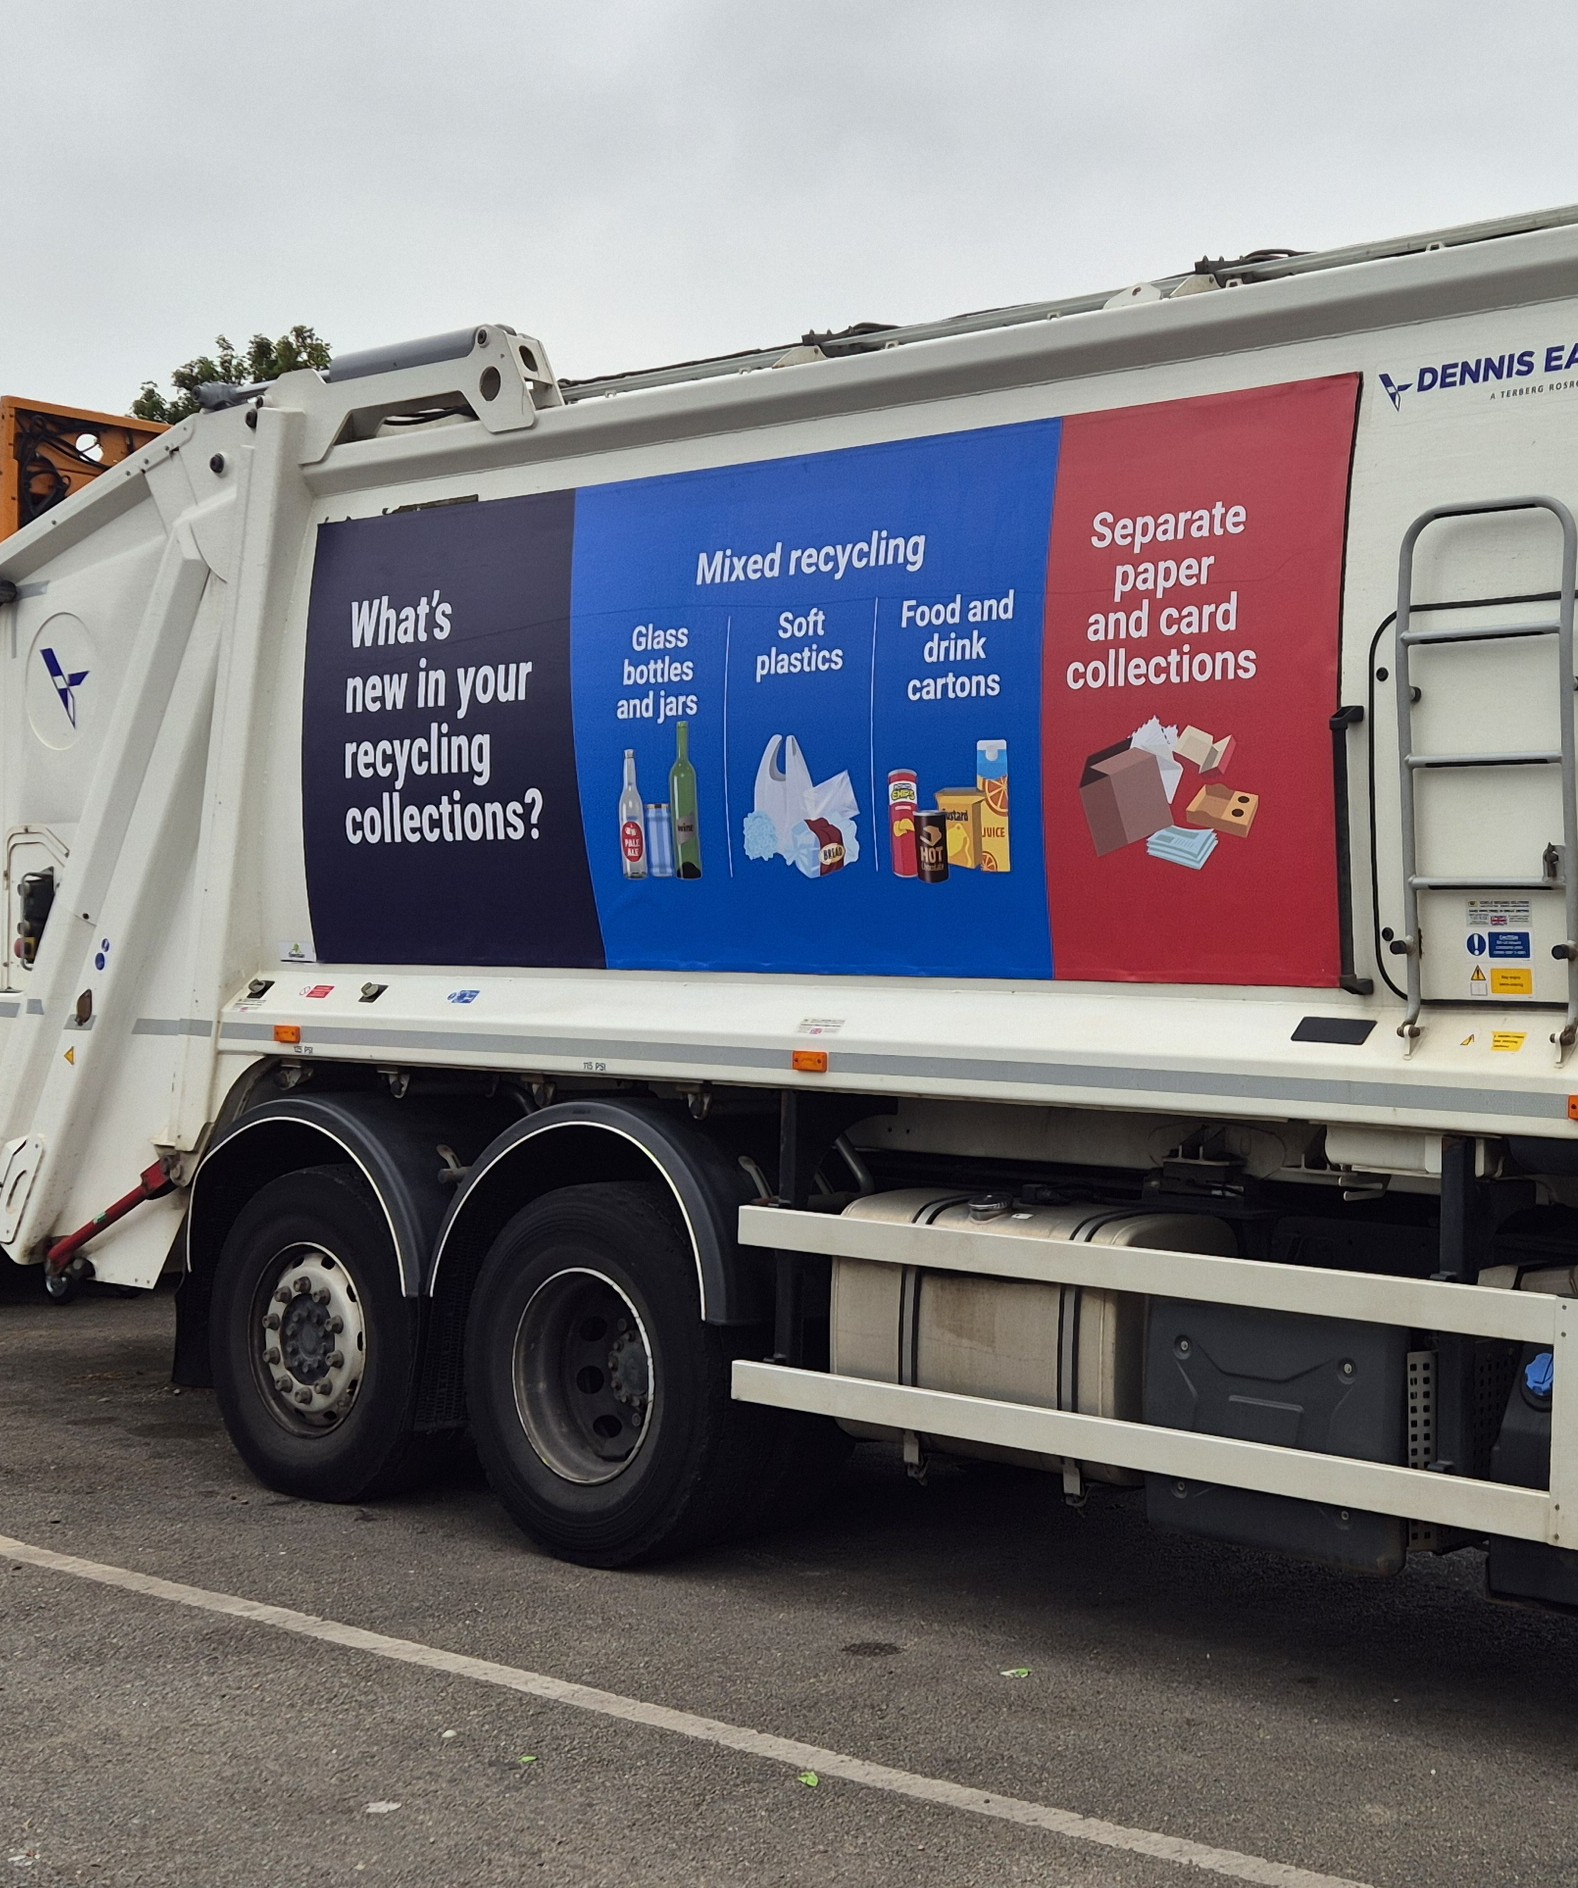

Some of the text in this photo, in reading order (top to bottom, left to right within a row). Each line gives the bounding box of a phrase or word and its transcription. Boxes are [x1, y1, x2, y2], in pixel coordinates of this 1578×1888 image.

[1416, 350, 1535, 392] DENNIS
[1490, 392, 1496, 400] A
[1500, 385, 1545, 399] TERBERG
[1091, 501, 1247, 554] Separate
[695, 529, 927, 585] Mixed recycling
[1114, 555, 1215, 603] paper
[351, 589, 453, 649] What's
[778, 607, 826, 640] Soft
[901, 589, 1016, 628] Food and
[1086, 590, 1238, 642] and card
[632, 624, 689, 652] Glass
[923, 629, 987, 664] drink
[623, 655, 694, 686] bottles
[755, 644, 844, 682] plastics
[1066, 643, 1257, 690] collections
[345, 657, 533, 719] new in your
[907, 670, 1001, 702] cartons
[616, 691, 698, 724] and jars
[344, 722, 491, 790] recycling
[345, 787, 544, 845] collections?
[942, 808, 968, 821] ustard
[981, 827, 1005, 838] JUICE
[823, 846, 844, 861] BREAD
[920, 845, 944, 863] HOT
